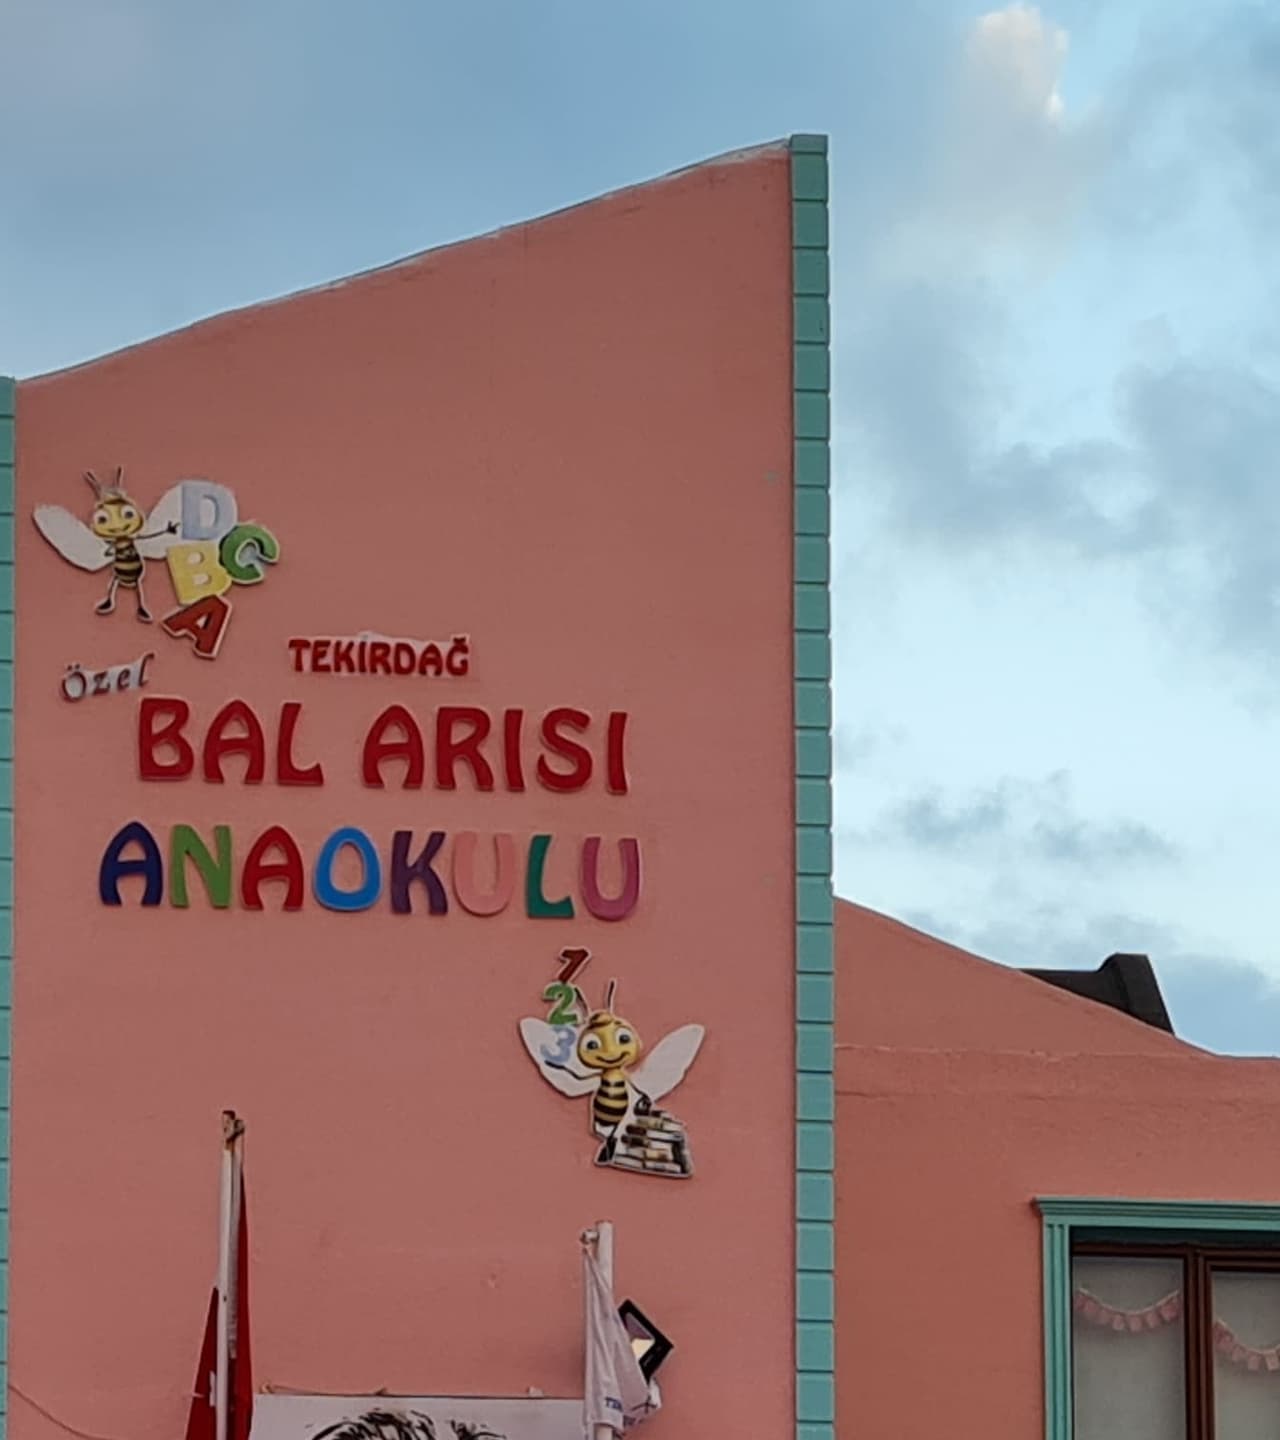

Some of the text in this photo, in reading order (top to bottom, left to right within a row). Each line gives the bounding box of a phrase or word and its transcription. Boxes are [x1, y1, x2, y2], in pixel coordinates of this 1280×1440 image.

[182, 482, 224, 541] D
[169, 543, 232, 605] B
[220, 524, 278, 583] C
[162, 595, 230, 657] A
[288, 634, 470, 677] TEKİRDAĞ
[62, 653, 155, 701] Özel
[138, 697, 629, 794] BAL ARISI
[99, 820, 641, 920] ANAOKULU
